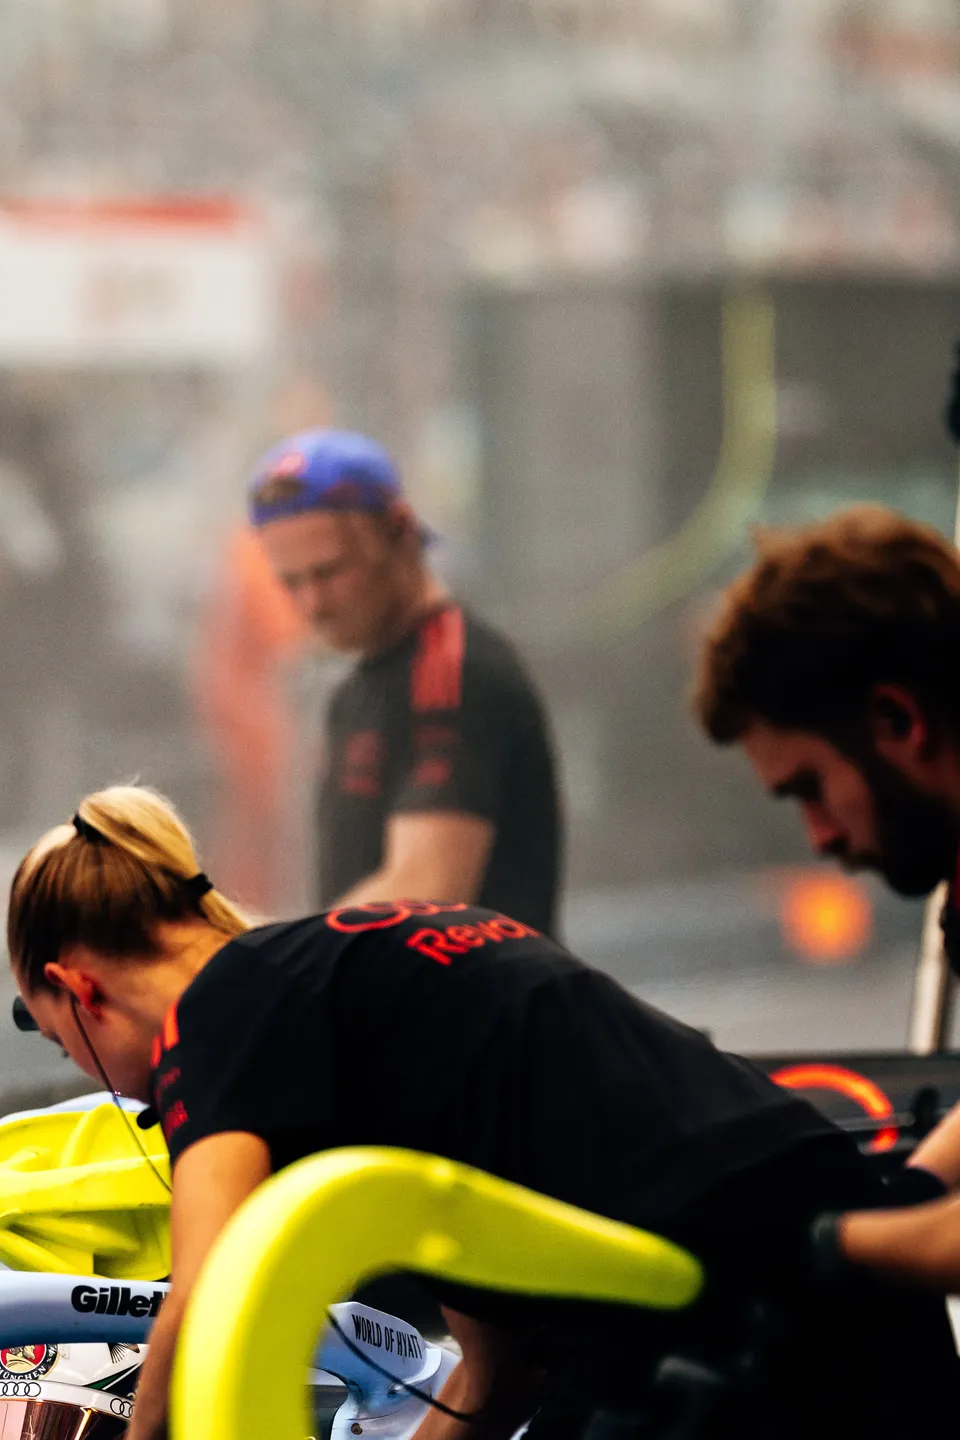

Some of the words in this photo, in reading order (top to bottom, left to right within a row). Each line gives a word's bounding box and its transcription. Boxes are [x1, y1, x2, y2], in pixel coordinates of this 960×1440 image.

[71, 1285, 170, 1318] Gillet
[352, 1314, 383, 1348] WORLD
[384, 1326, 395, 1354] OF
[396, 1330, 423, 1359] HYATT
